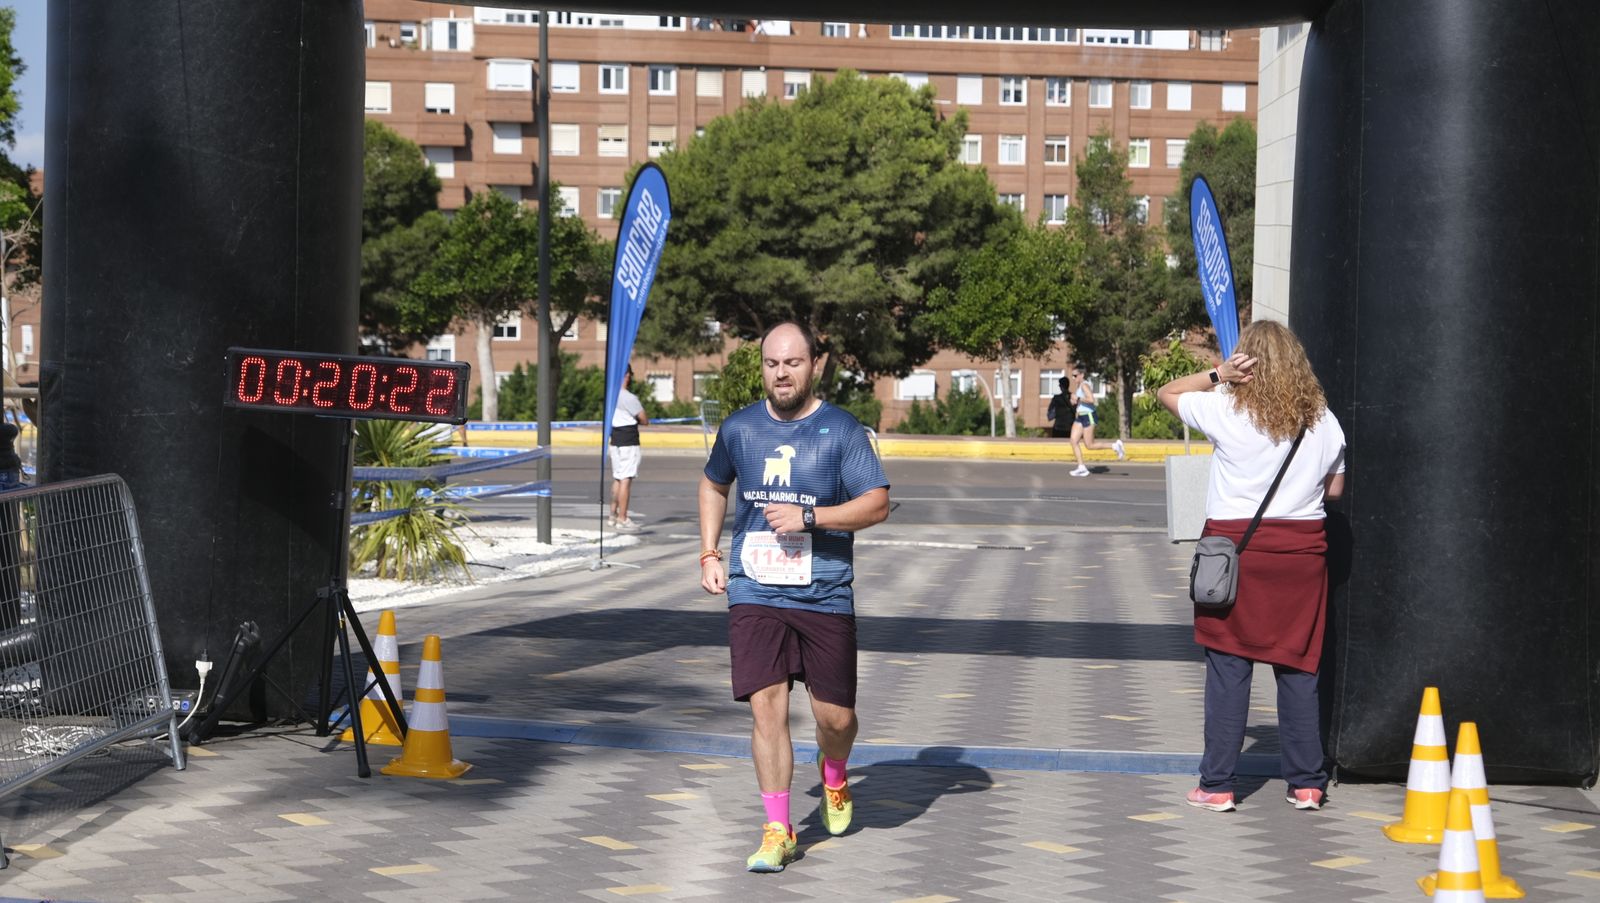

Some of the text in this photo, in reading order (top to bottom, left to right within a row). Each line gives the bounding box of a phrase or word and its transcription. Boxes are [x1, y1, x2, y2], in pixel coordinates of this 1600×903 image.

[237, 356, 455, 416] 00:20:22
[769, 491, 799, 503] MARMOL
[800, 494, 817, 506] CXM
[750, 548, 803, 566] 1144
